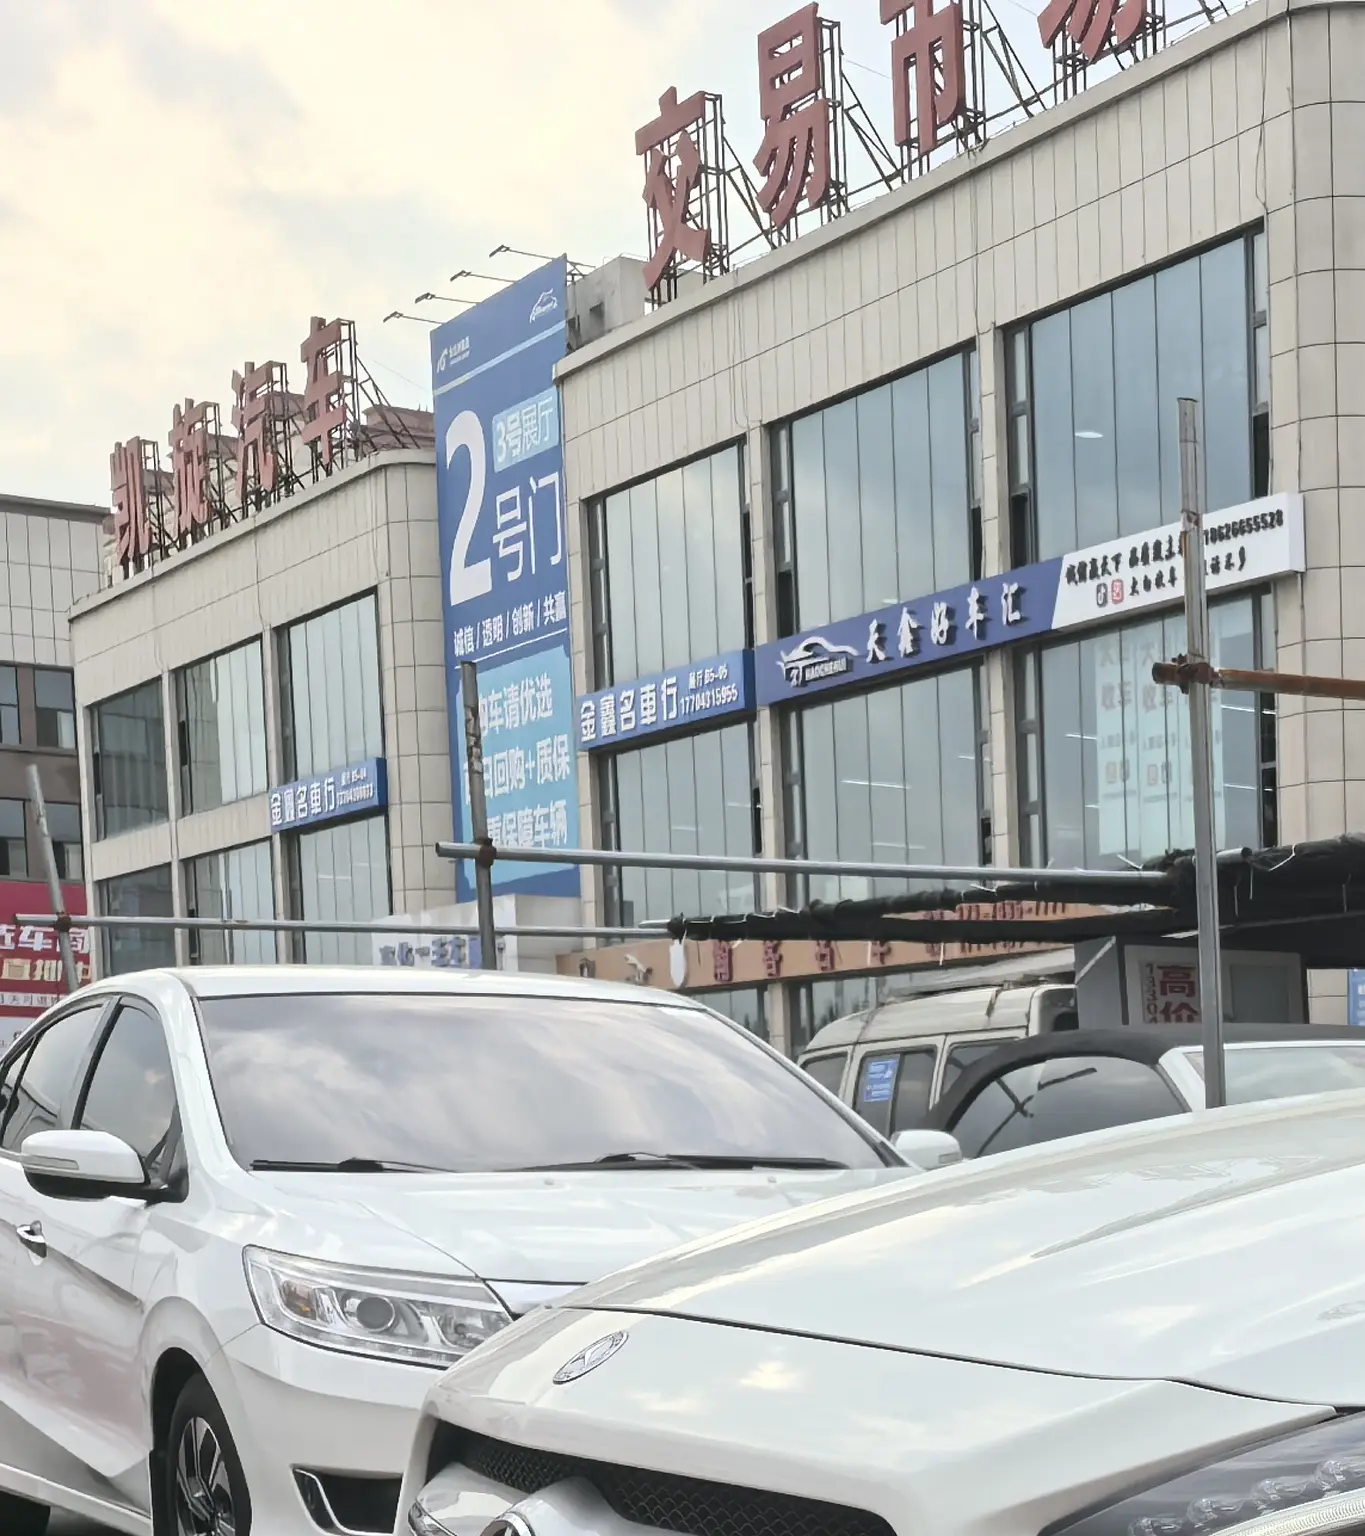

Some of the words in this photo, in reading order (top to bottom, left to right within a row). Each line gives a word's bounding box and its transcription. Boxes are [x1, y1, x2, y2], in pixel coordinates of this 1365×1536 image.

[496, 396, 554, 464] 3号展厅
[487, 799, 567, 849] 重保障车辆
